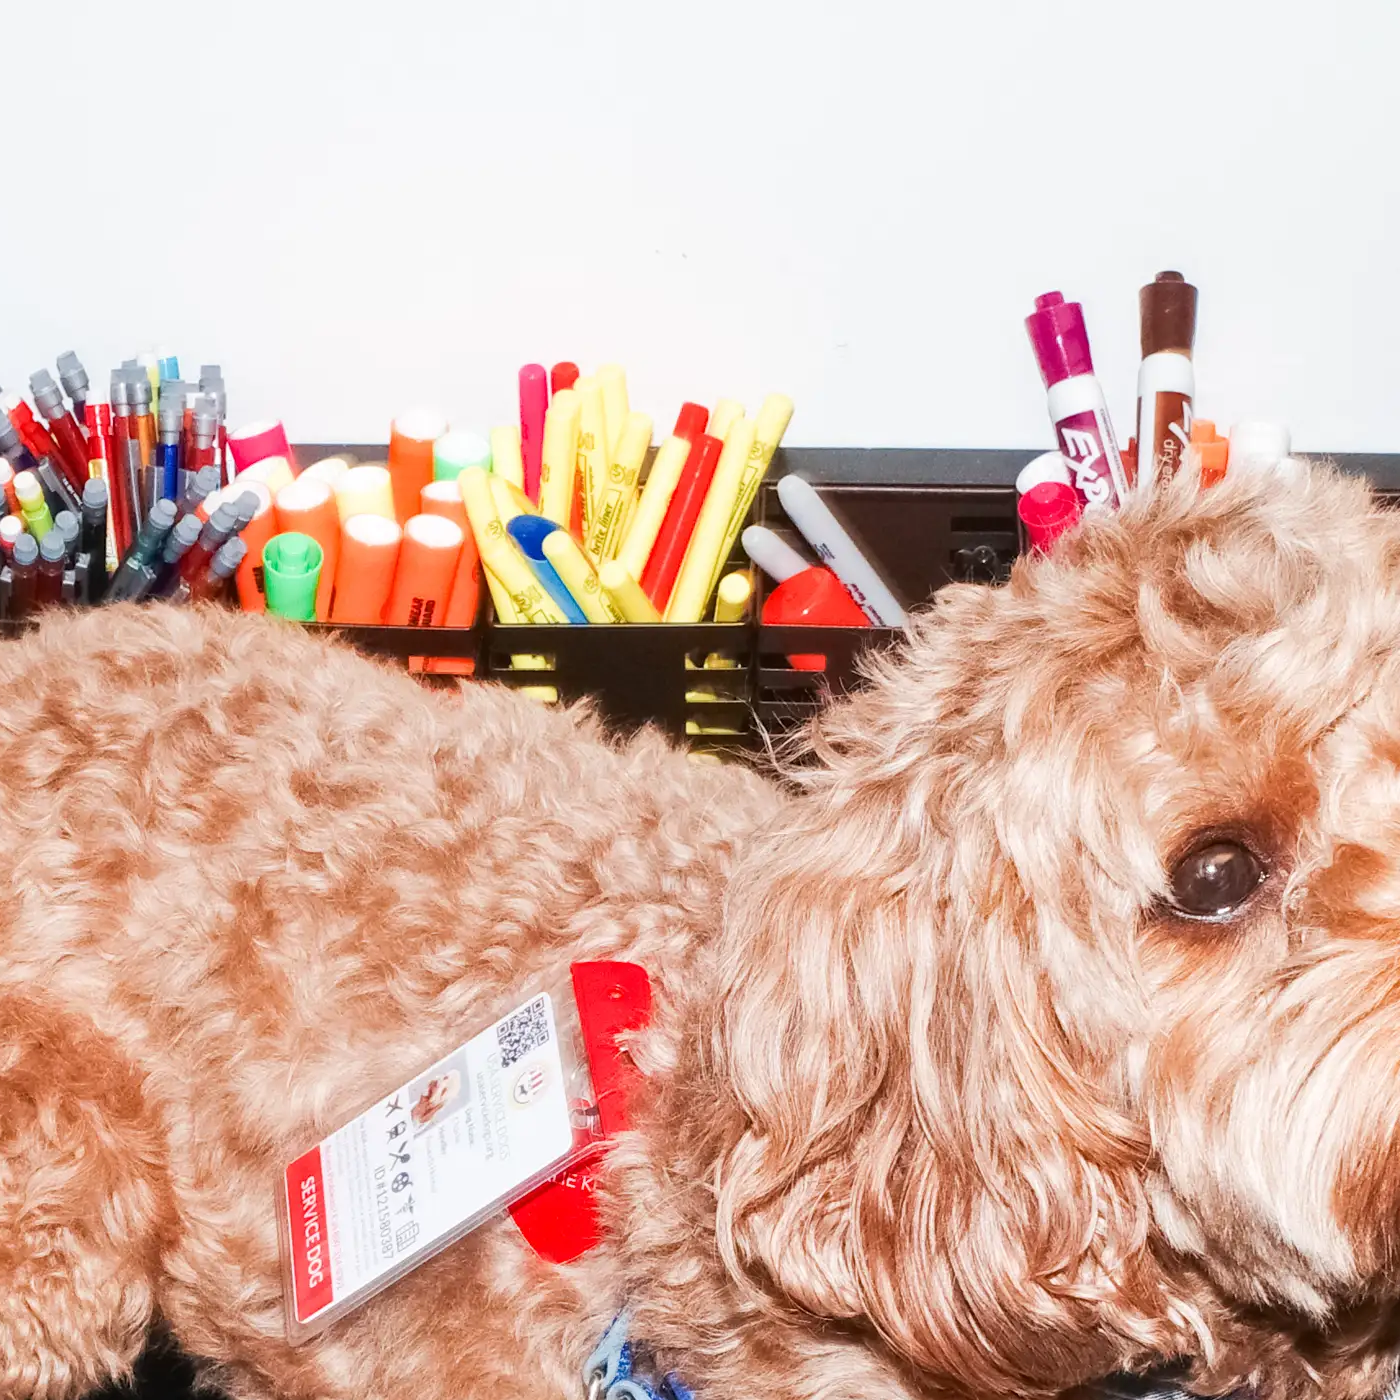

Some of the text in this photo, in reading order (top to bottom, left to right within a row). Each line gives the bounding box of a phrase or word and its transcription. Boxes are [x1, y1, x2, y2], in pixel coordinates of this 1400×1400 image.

[1061, 427, 1110, 503] EXP
[587, 525, 606, 556] brite
[597, 501, 614, 529] liner
[374, 1165, 387, 1181] ID
[301, 1175, 324, 1289] SERVICE DOG
